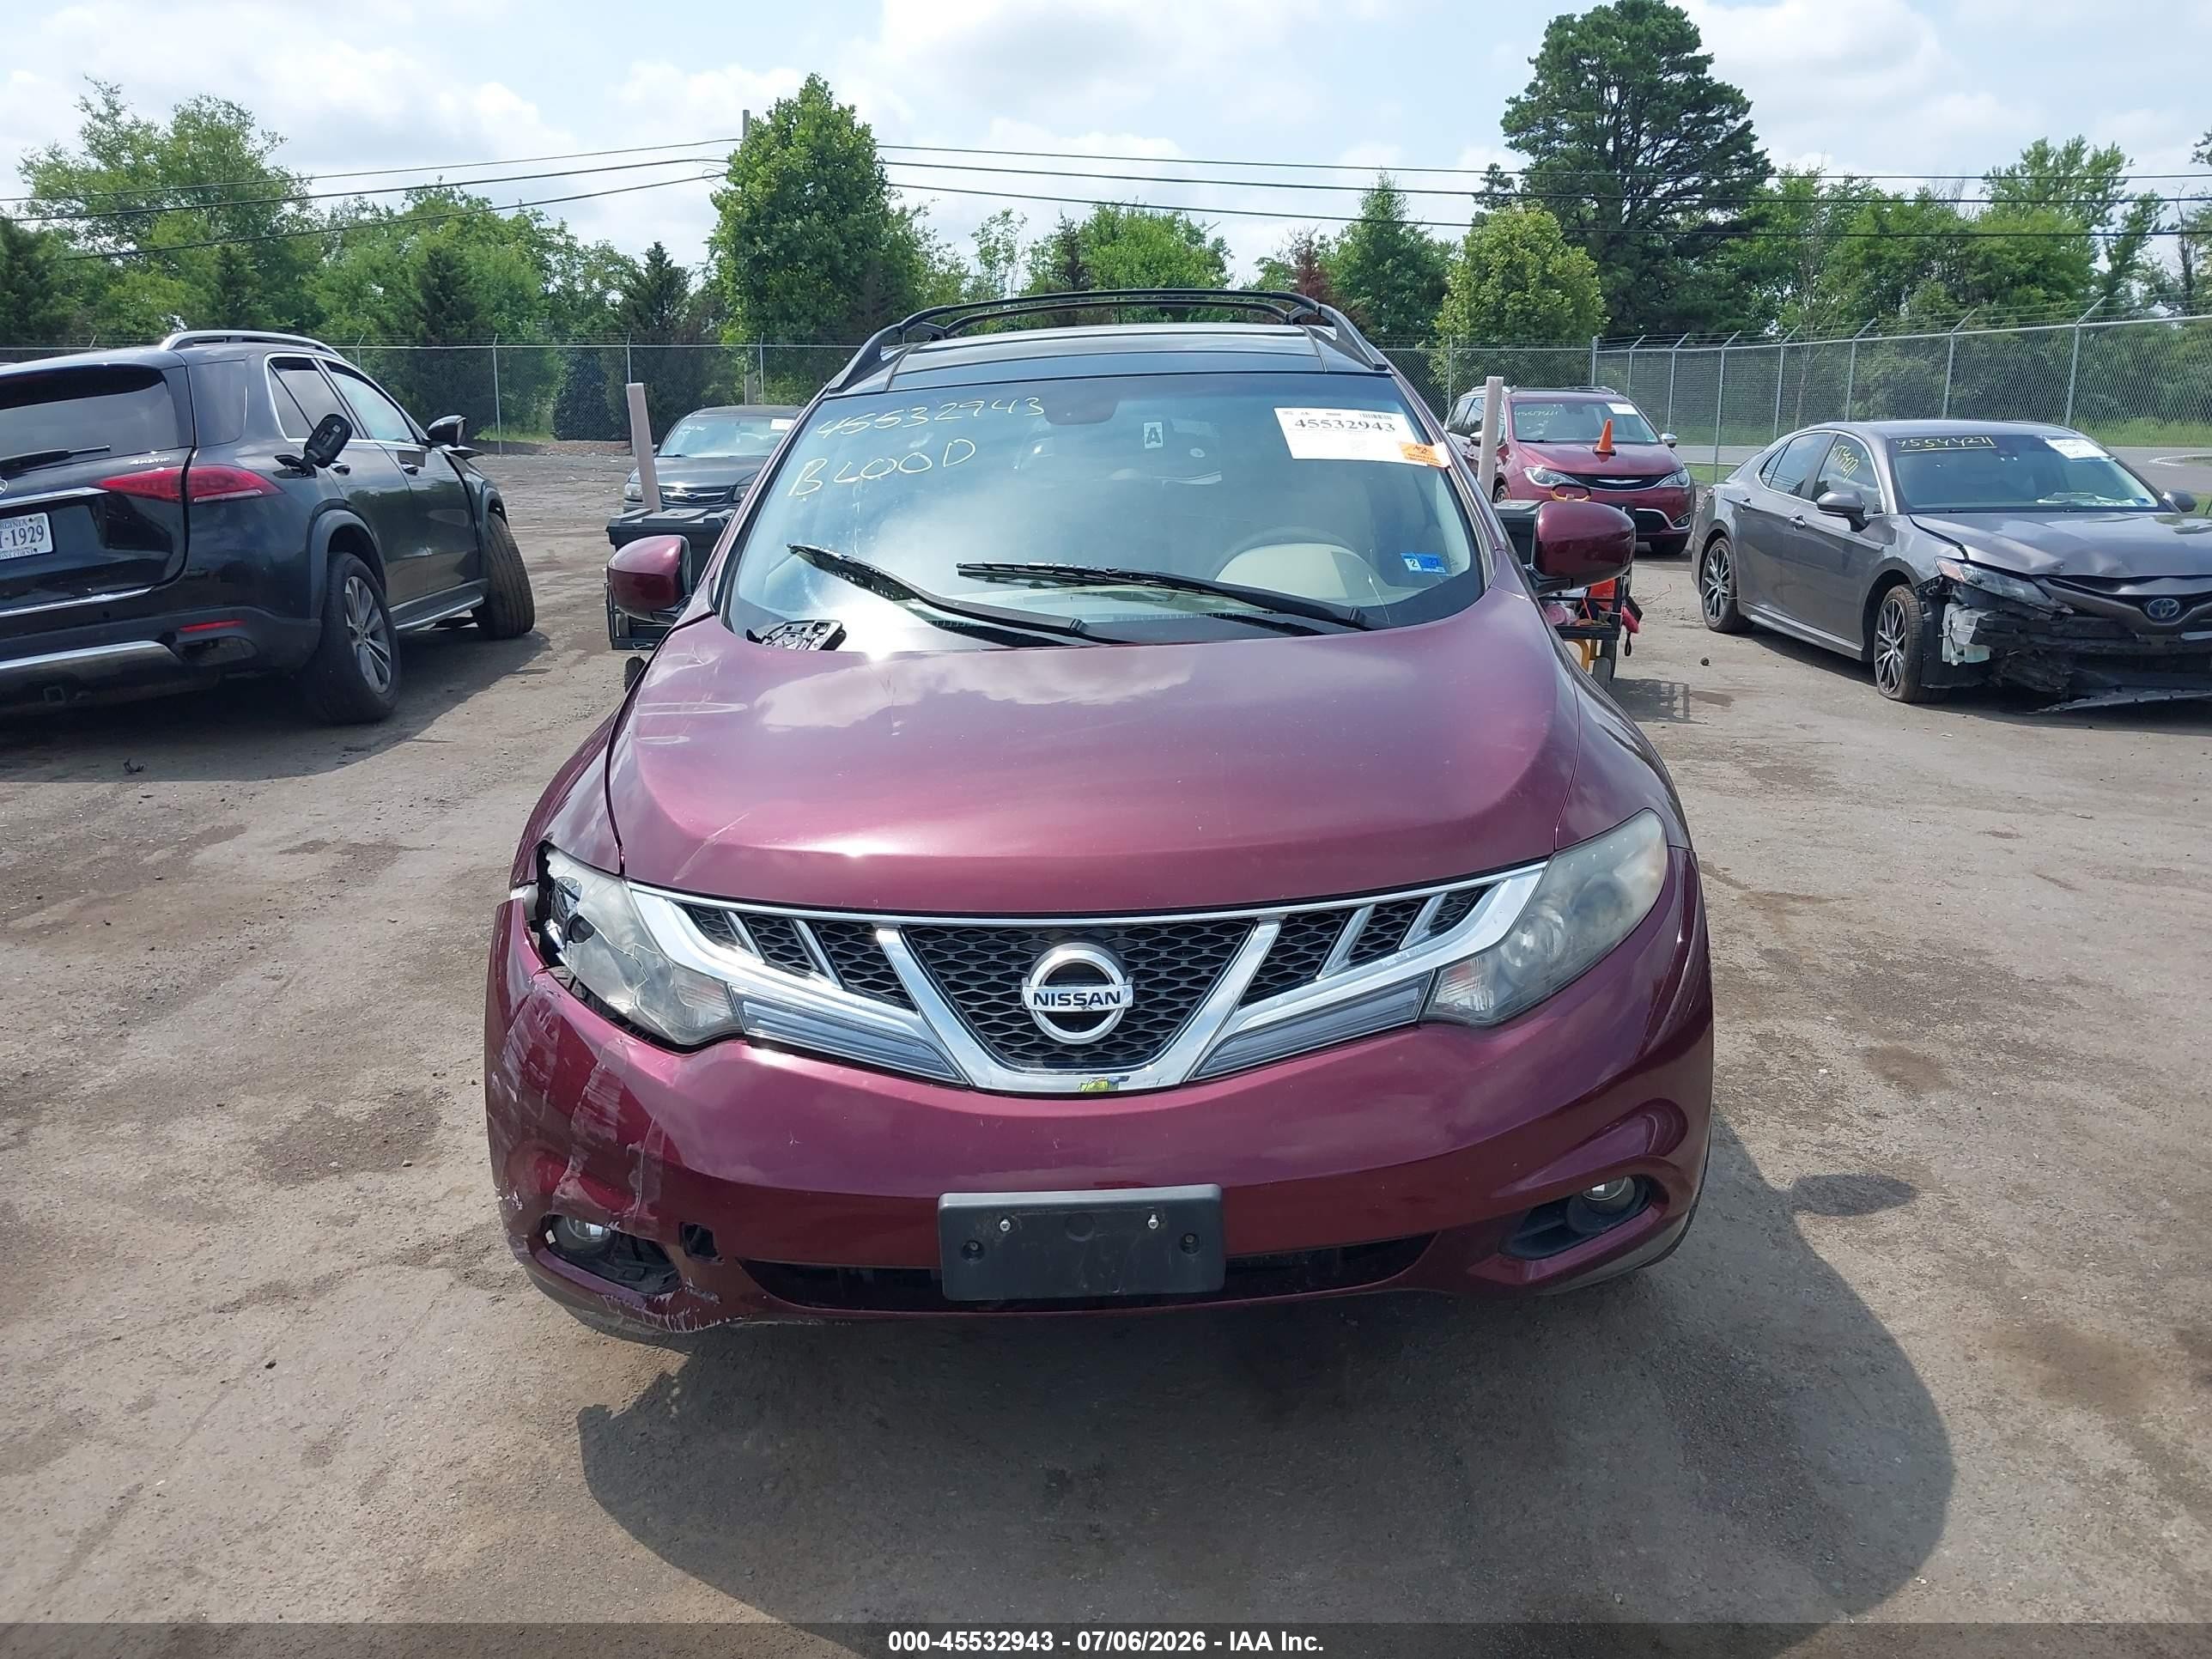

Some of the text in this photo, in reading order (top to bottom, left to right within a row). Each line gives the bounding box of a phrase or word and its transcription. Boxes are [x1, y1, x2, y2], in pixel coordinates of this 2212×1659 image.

[817, 397, 1045, 439] 45532943
[1294, 418, 1395, 432] 45532943
[1146, 427, 1162, 444] A
[1895, 434, 1996, 447] 45544271
[787, 438, 976, 498] BLOOD
[1409, 559, 1419, 568] 2
[1033, 991, 1121, 1006] NISSAN
